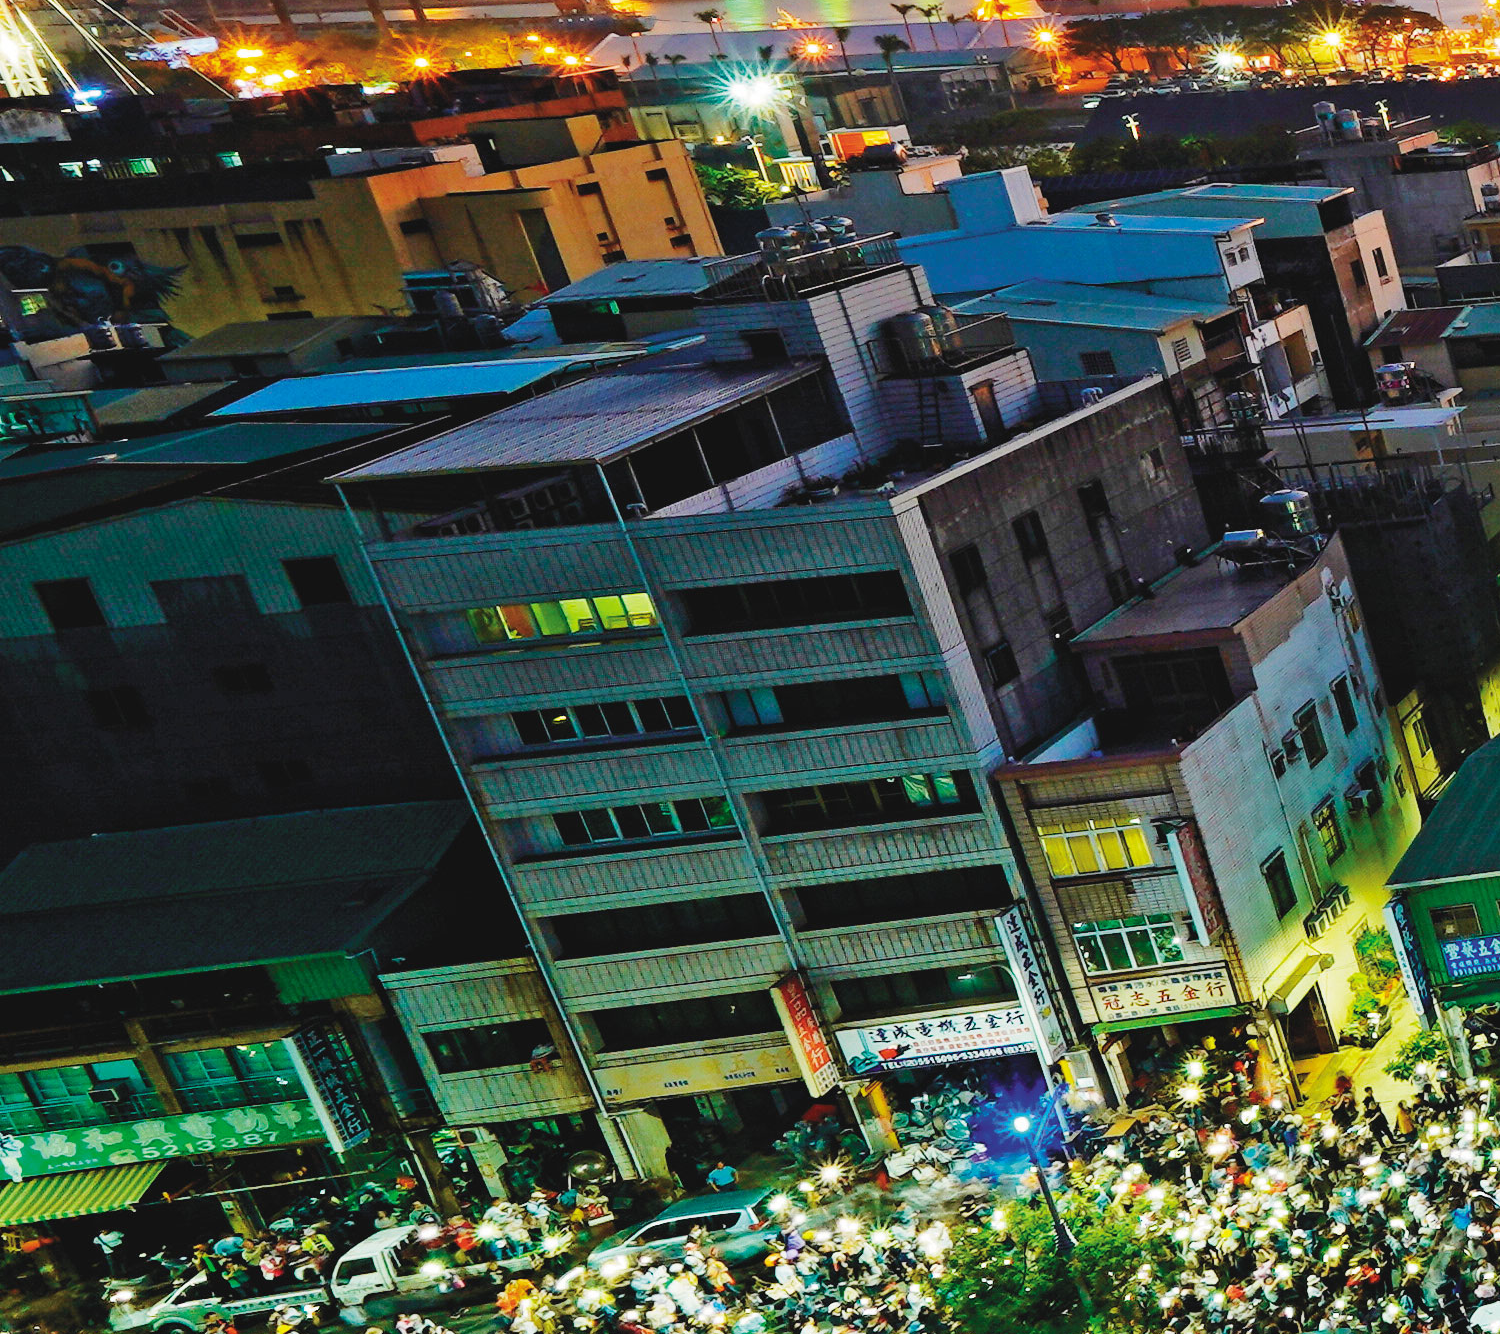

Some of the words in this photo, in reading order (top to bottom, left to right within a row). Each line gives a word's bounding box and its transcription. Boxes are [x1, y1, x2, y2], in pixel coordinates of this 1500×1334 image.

[1101, 980, 1227, 1012] 冠志五金行
[867, 1009, 1026, 1045] 達成電機五金行
